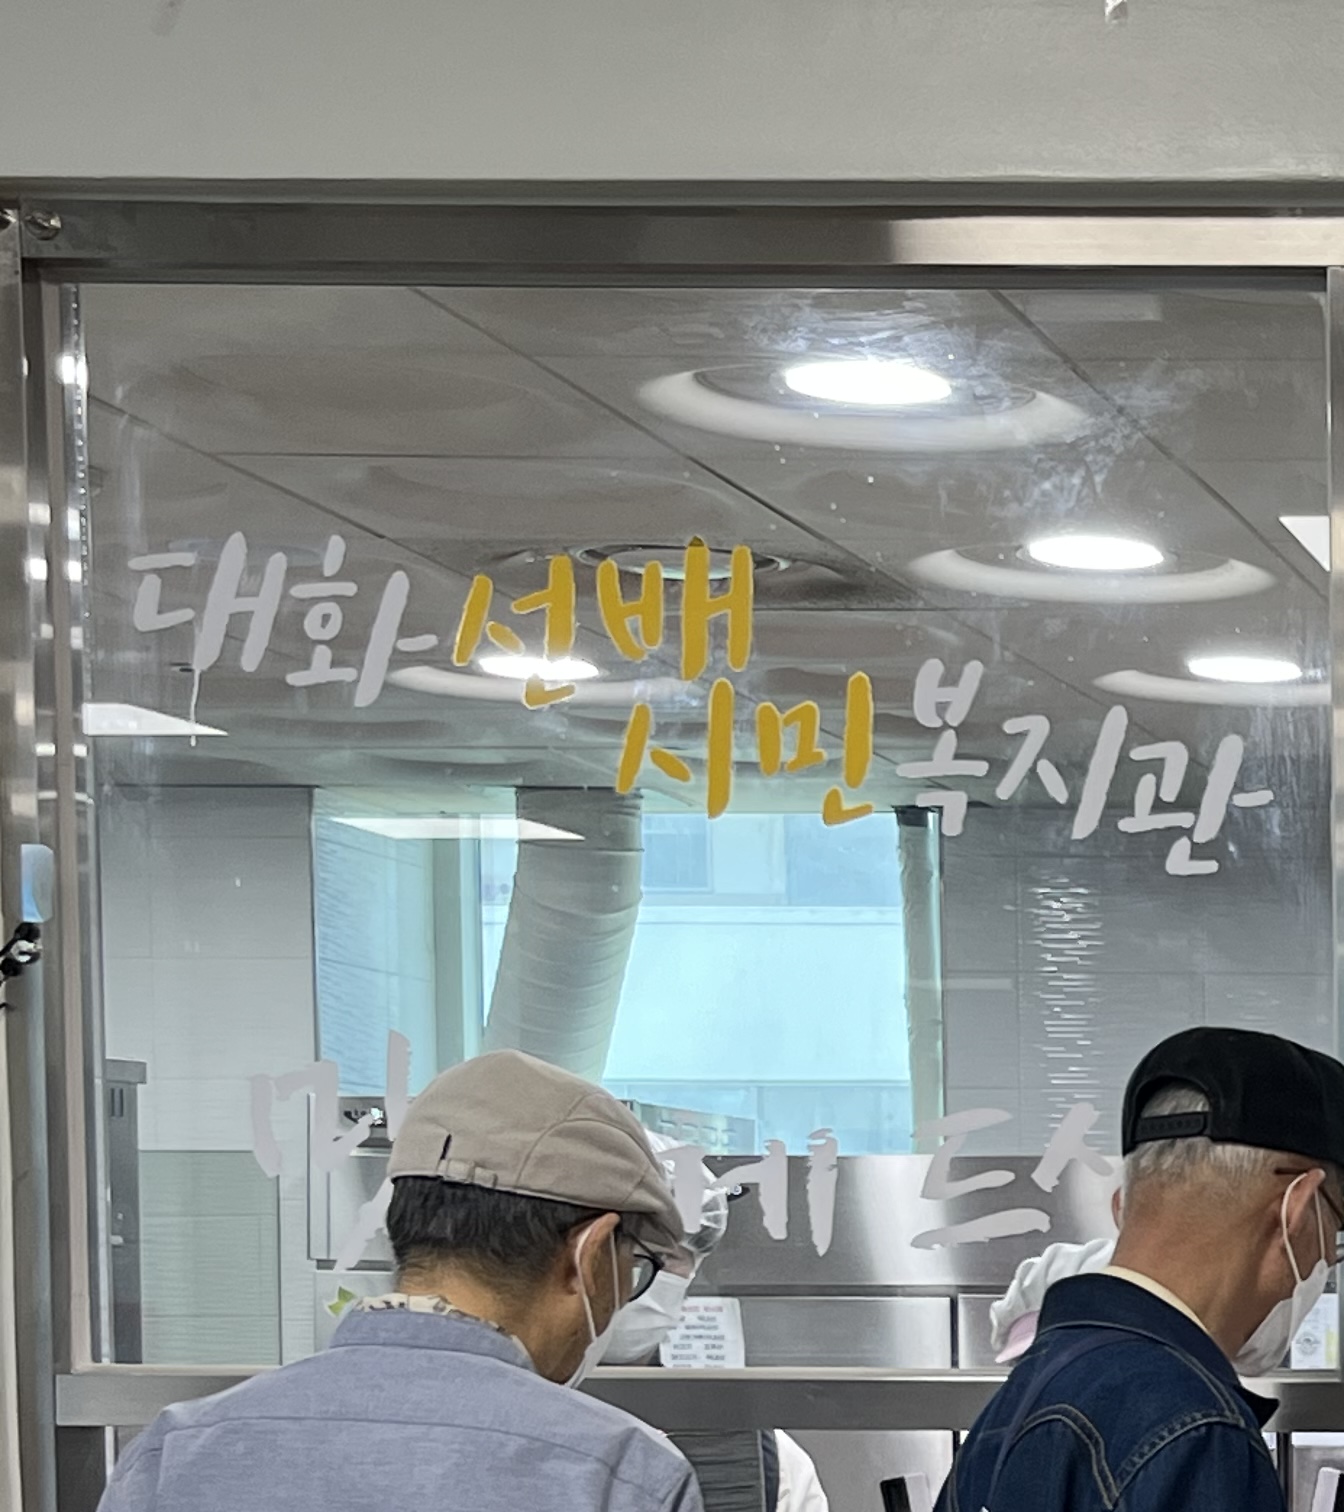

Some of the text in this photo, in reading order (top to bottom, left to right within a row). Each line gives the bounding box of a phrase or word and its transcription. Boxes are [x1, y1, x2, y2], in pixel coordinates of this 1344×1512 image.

[128, 531, 754, 710] 대화 선배
[614, 657, 1274, 876] 시민 복지관
